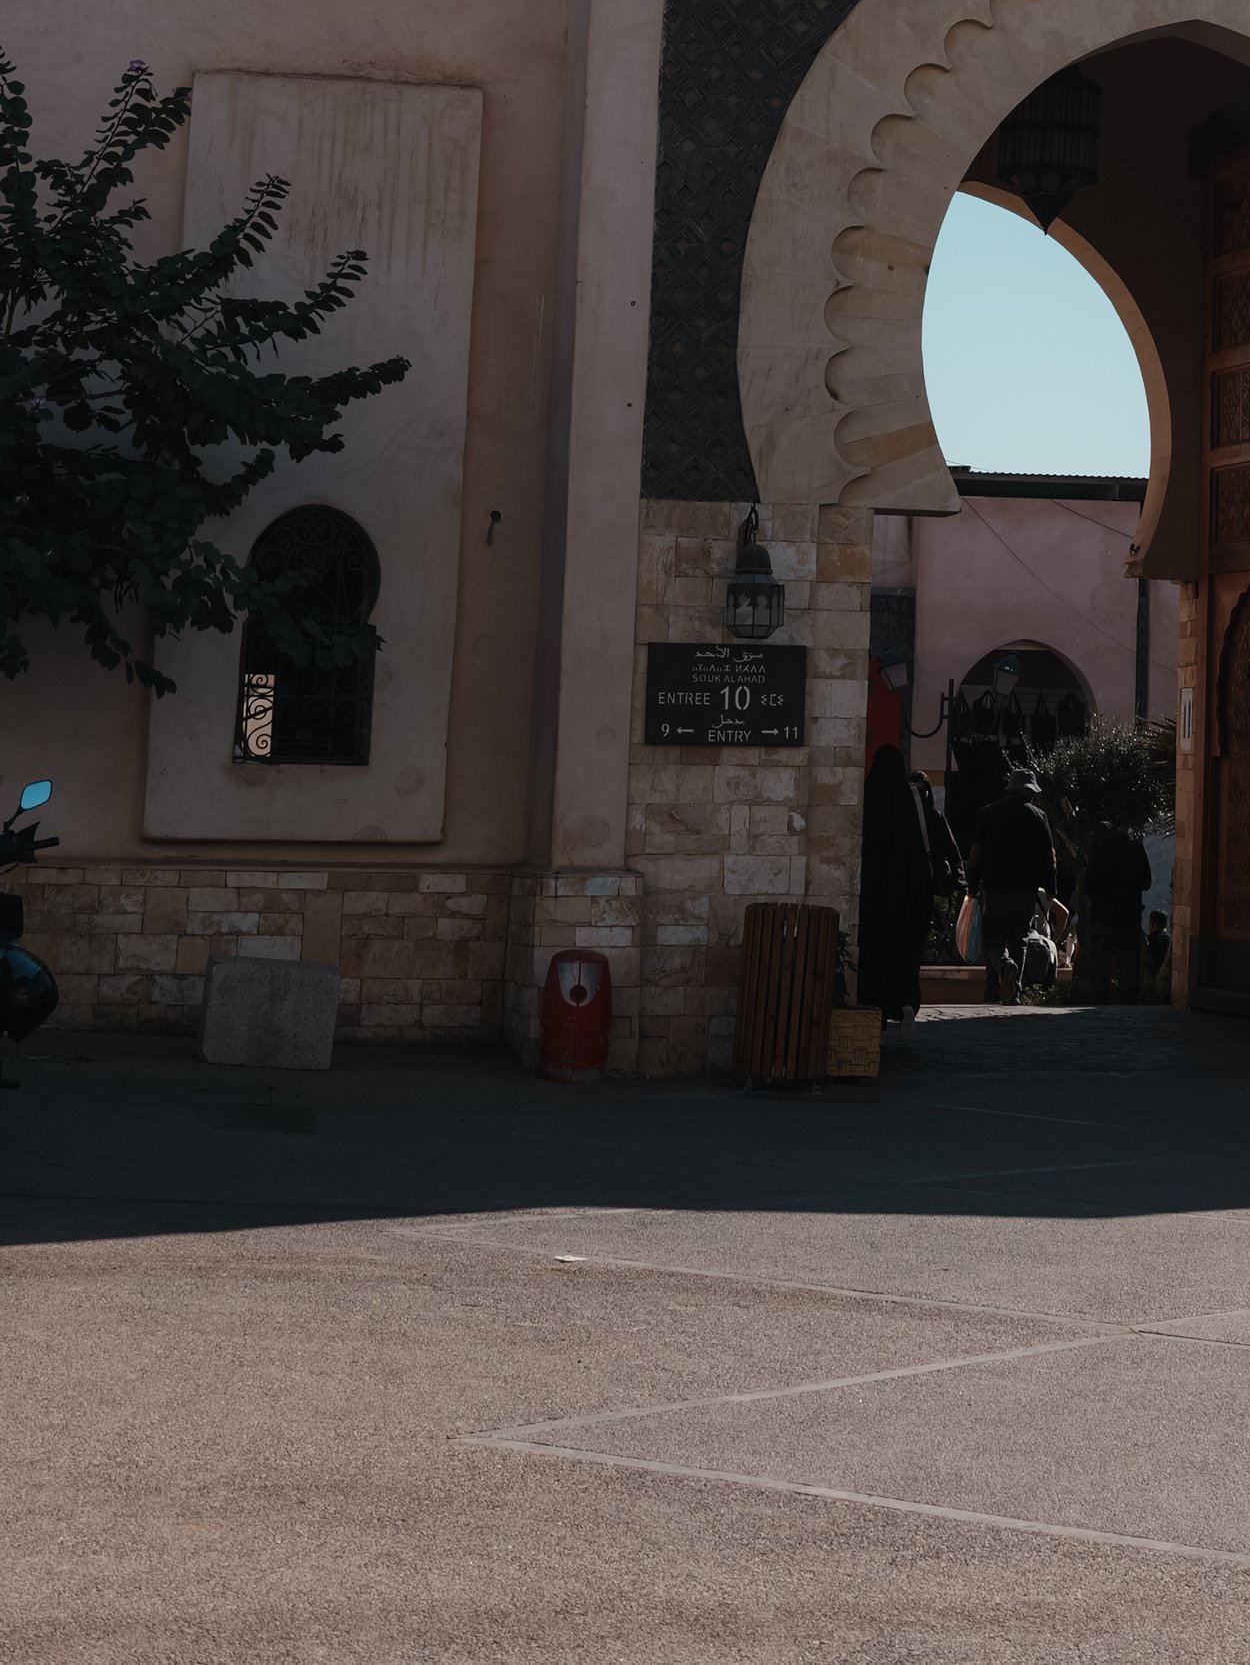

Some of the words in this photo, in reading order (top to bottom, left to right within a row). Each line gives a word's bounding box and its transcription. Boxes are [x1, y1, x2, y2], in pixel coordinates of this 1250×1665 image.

[733, 648, 763, 663] سوق
[692, 674, 721, 683] SOUK
[723, 675, 735, 683] AL
[737, 675, 766, 684] AHAD
[658, 692, 711, 705] ENTREE
[720, 685, 751, 711] 10
[661, 723, 670, 737] 9
[708, 729, 752, 743] ENTRY
[784, 725, 799, 740] 11
